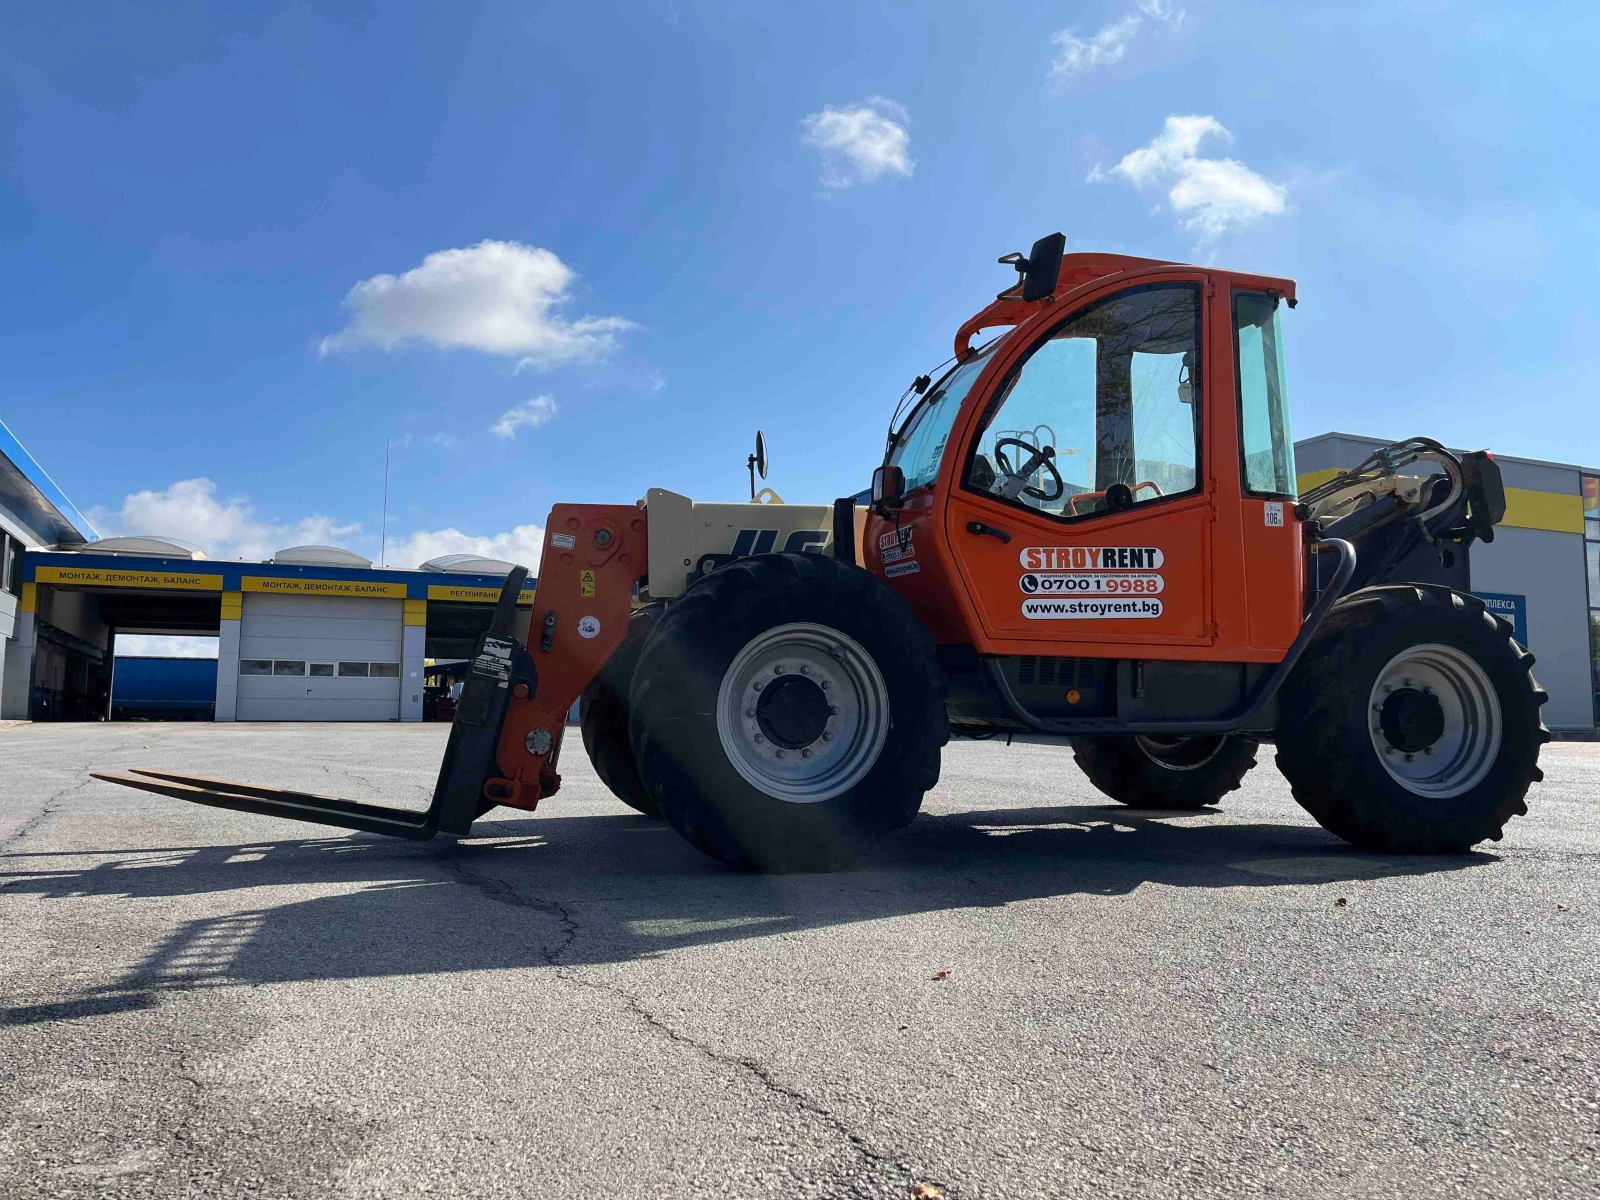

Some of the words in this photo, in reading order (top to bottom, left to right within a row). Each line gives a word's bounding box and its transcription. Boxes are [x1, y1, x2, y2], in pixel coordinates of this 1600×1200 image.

[1266, 512, 1278, 524] 106
[1026, 548, 1157, 569] STROYRENT
[59, 572, 103, 582] МОНТАЖ,
[105, 574, 161, 584] ДЕМОНТАЖ,
[163, 576, 201, 585] БАЛАНС
[262, 581, 302, 590] МОНТАЖ,
[304, 583, 353, 592] ДЕМОНТАЖ,
[355, 585, 388, 594] БАЛАНС
[1041, 579, 1090, 590] 0700
[1094, 579, 1101, 590] 1
[1106, 579, 1158, 593] 9988
[450, 590, 498, 599] РЕГУЛИРАНЕ
[1026, 601, 1160, 616] www.stroyrent.bg
